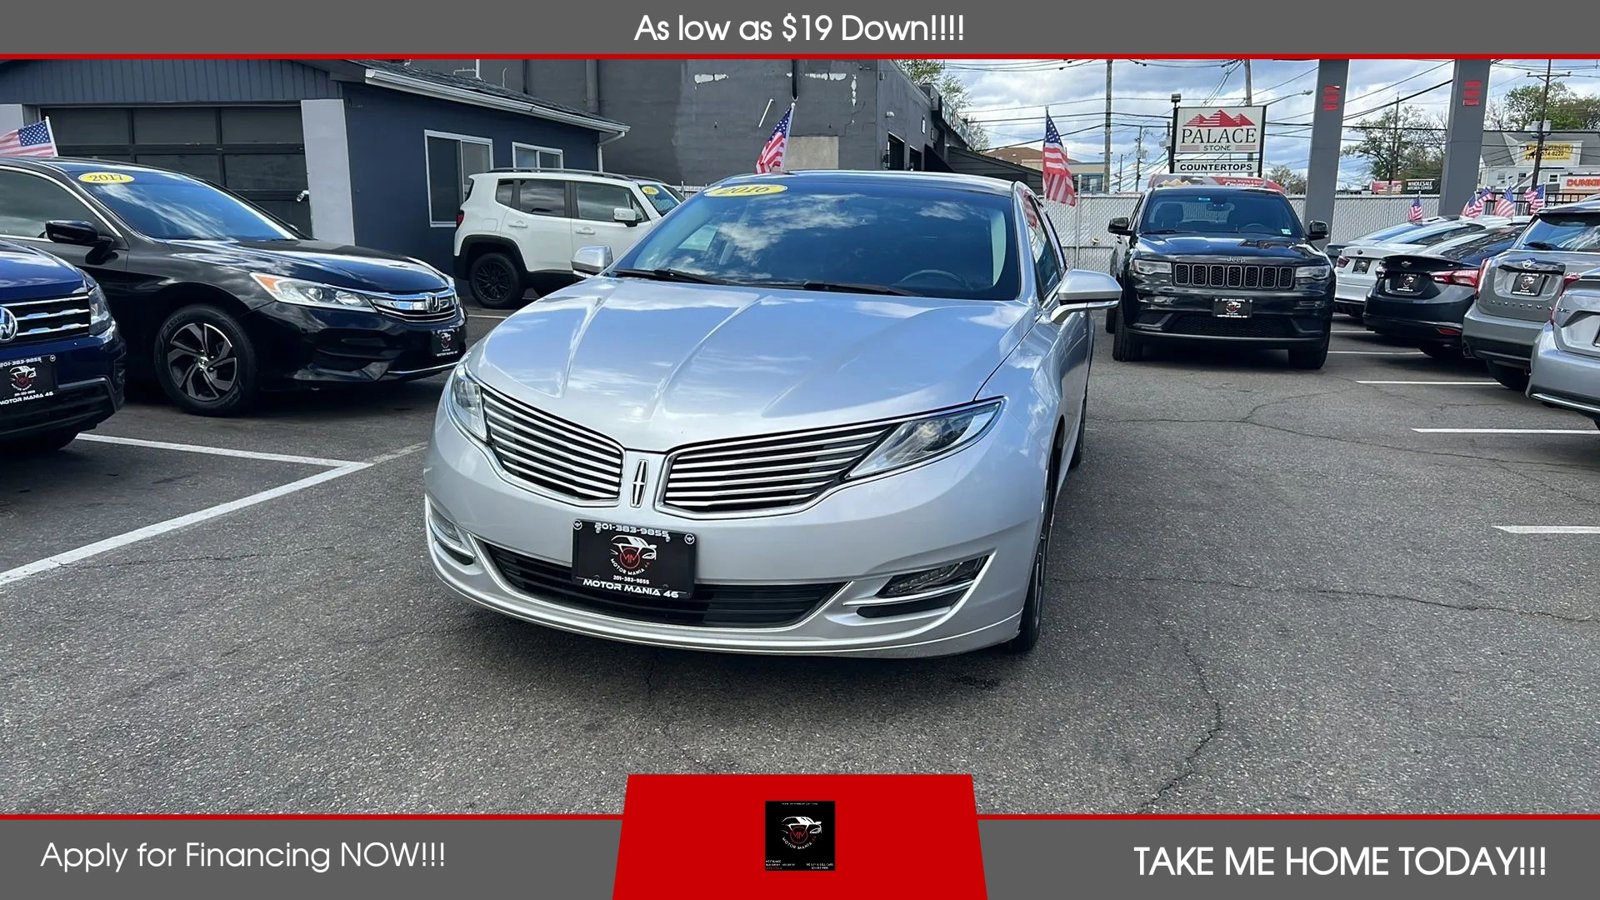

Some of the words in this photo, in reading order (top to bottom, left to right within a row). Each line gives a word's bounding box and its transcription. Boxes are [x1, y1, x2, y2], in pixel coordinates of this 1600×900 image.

[1181, 128, 1257, 144] PALACE
[1180, 163, 1253, 171] COUNTERTOPS
[90, 174, 123, 182] 2017
[23, 393, 44, 401] MANIA
[594, 522, 671, 537] 201-383-9855
[610, 558, 627, 574] MOTOR
[583, 579, 622, 591] MOTOR
[624, 585, 661, 596] MANIA
[663, 591, 679, 599] 46
